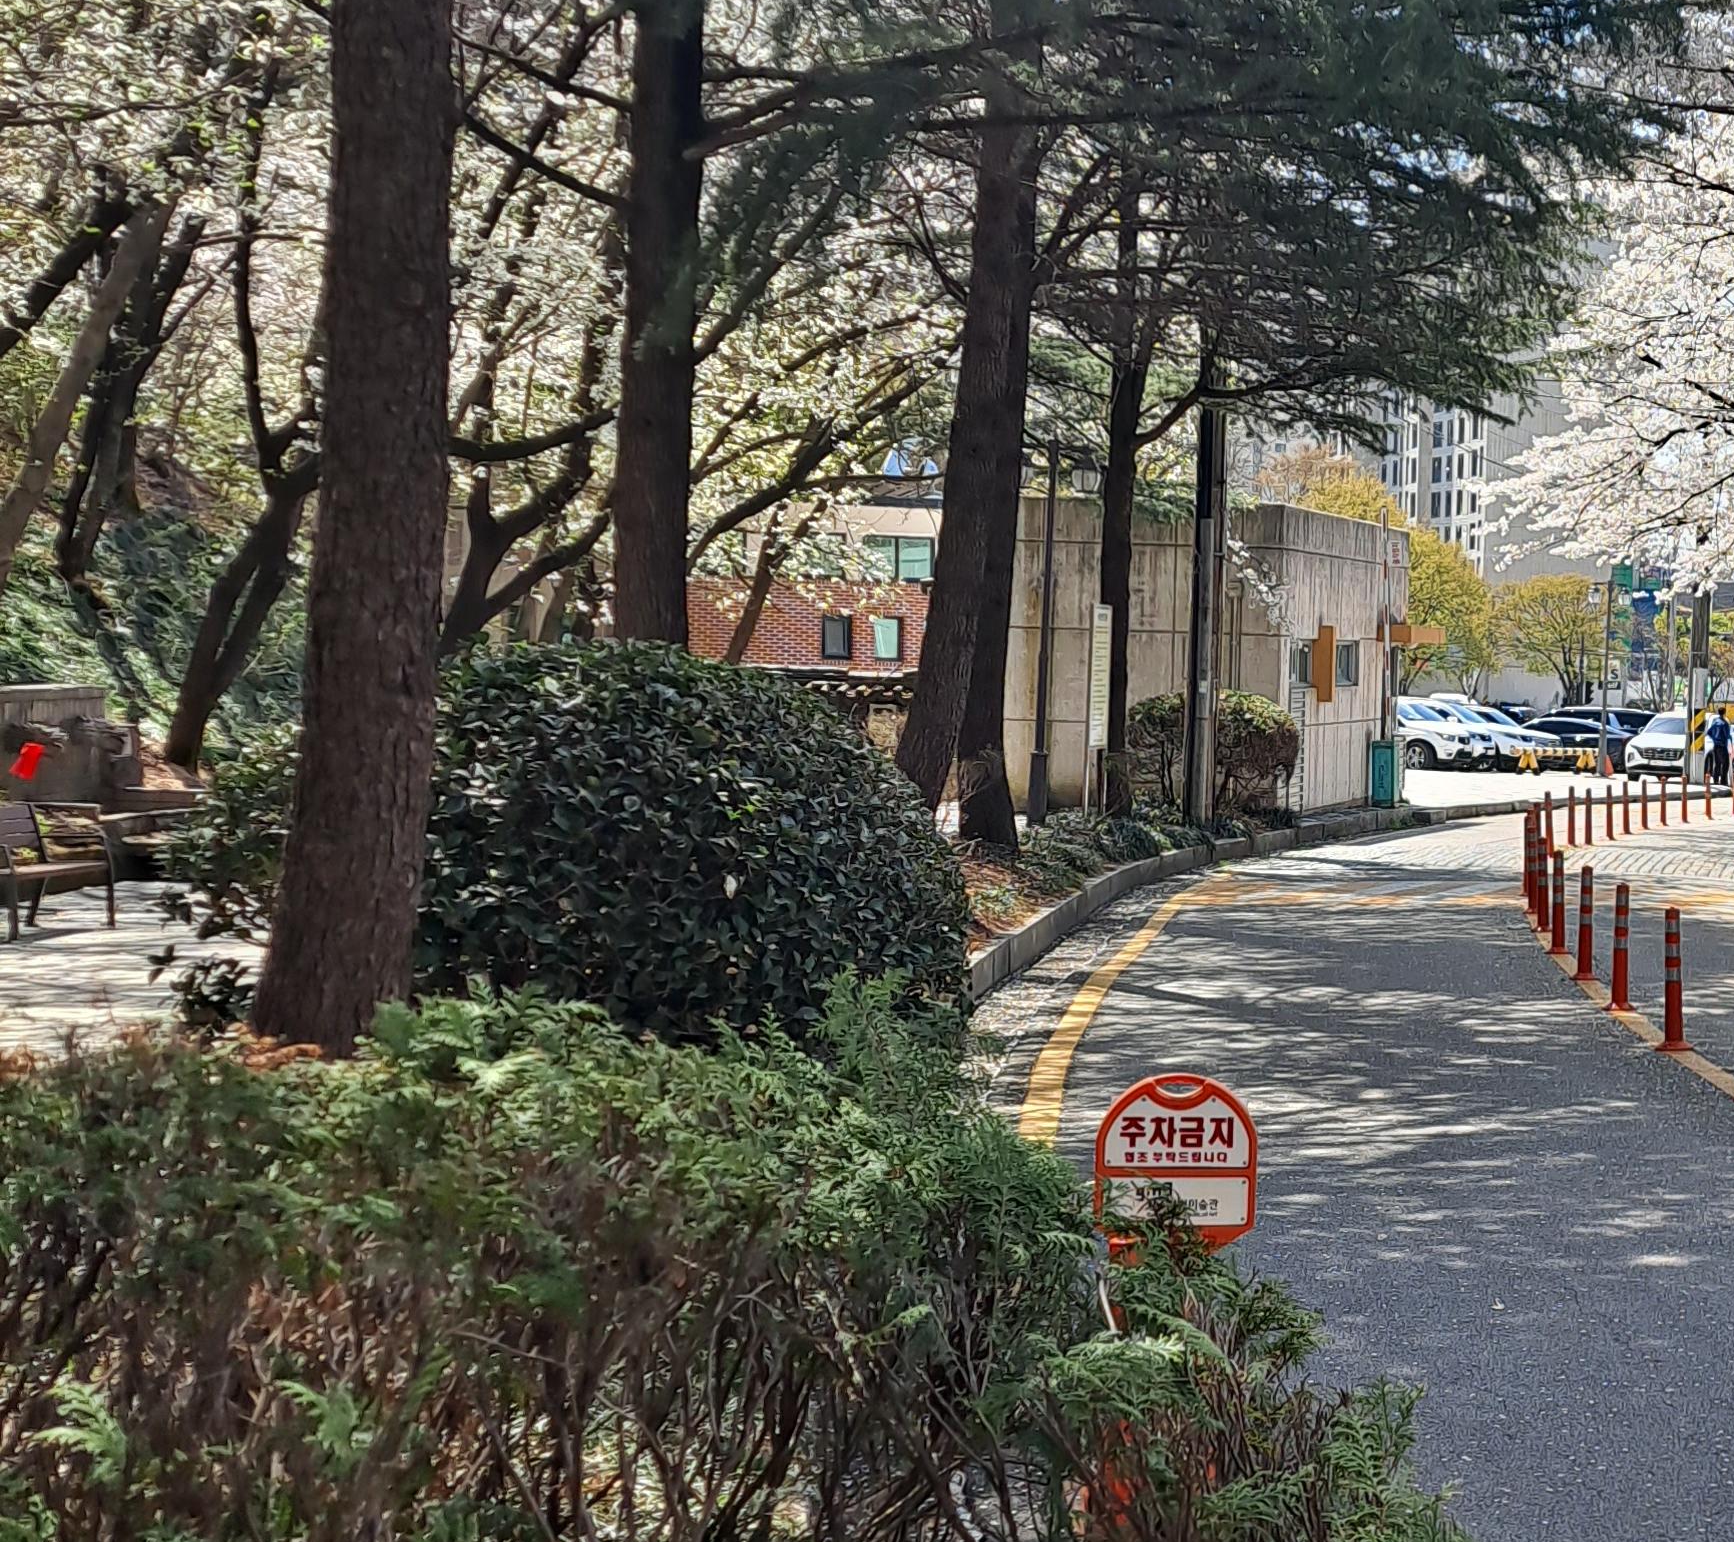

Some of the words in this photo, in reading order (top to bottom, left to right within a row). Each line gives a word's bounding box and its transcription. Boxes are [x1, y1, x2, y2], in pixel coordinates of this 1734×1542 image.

[1119, 1116, 1235, 1148] 주차금지
[1124, 1151, 1148, 1163] 협조
[1152, 1151, 1228, 1163] 부탁드립니다
